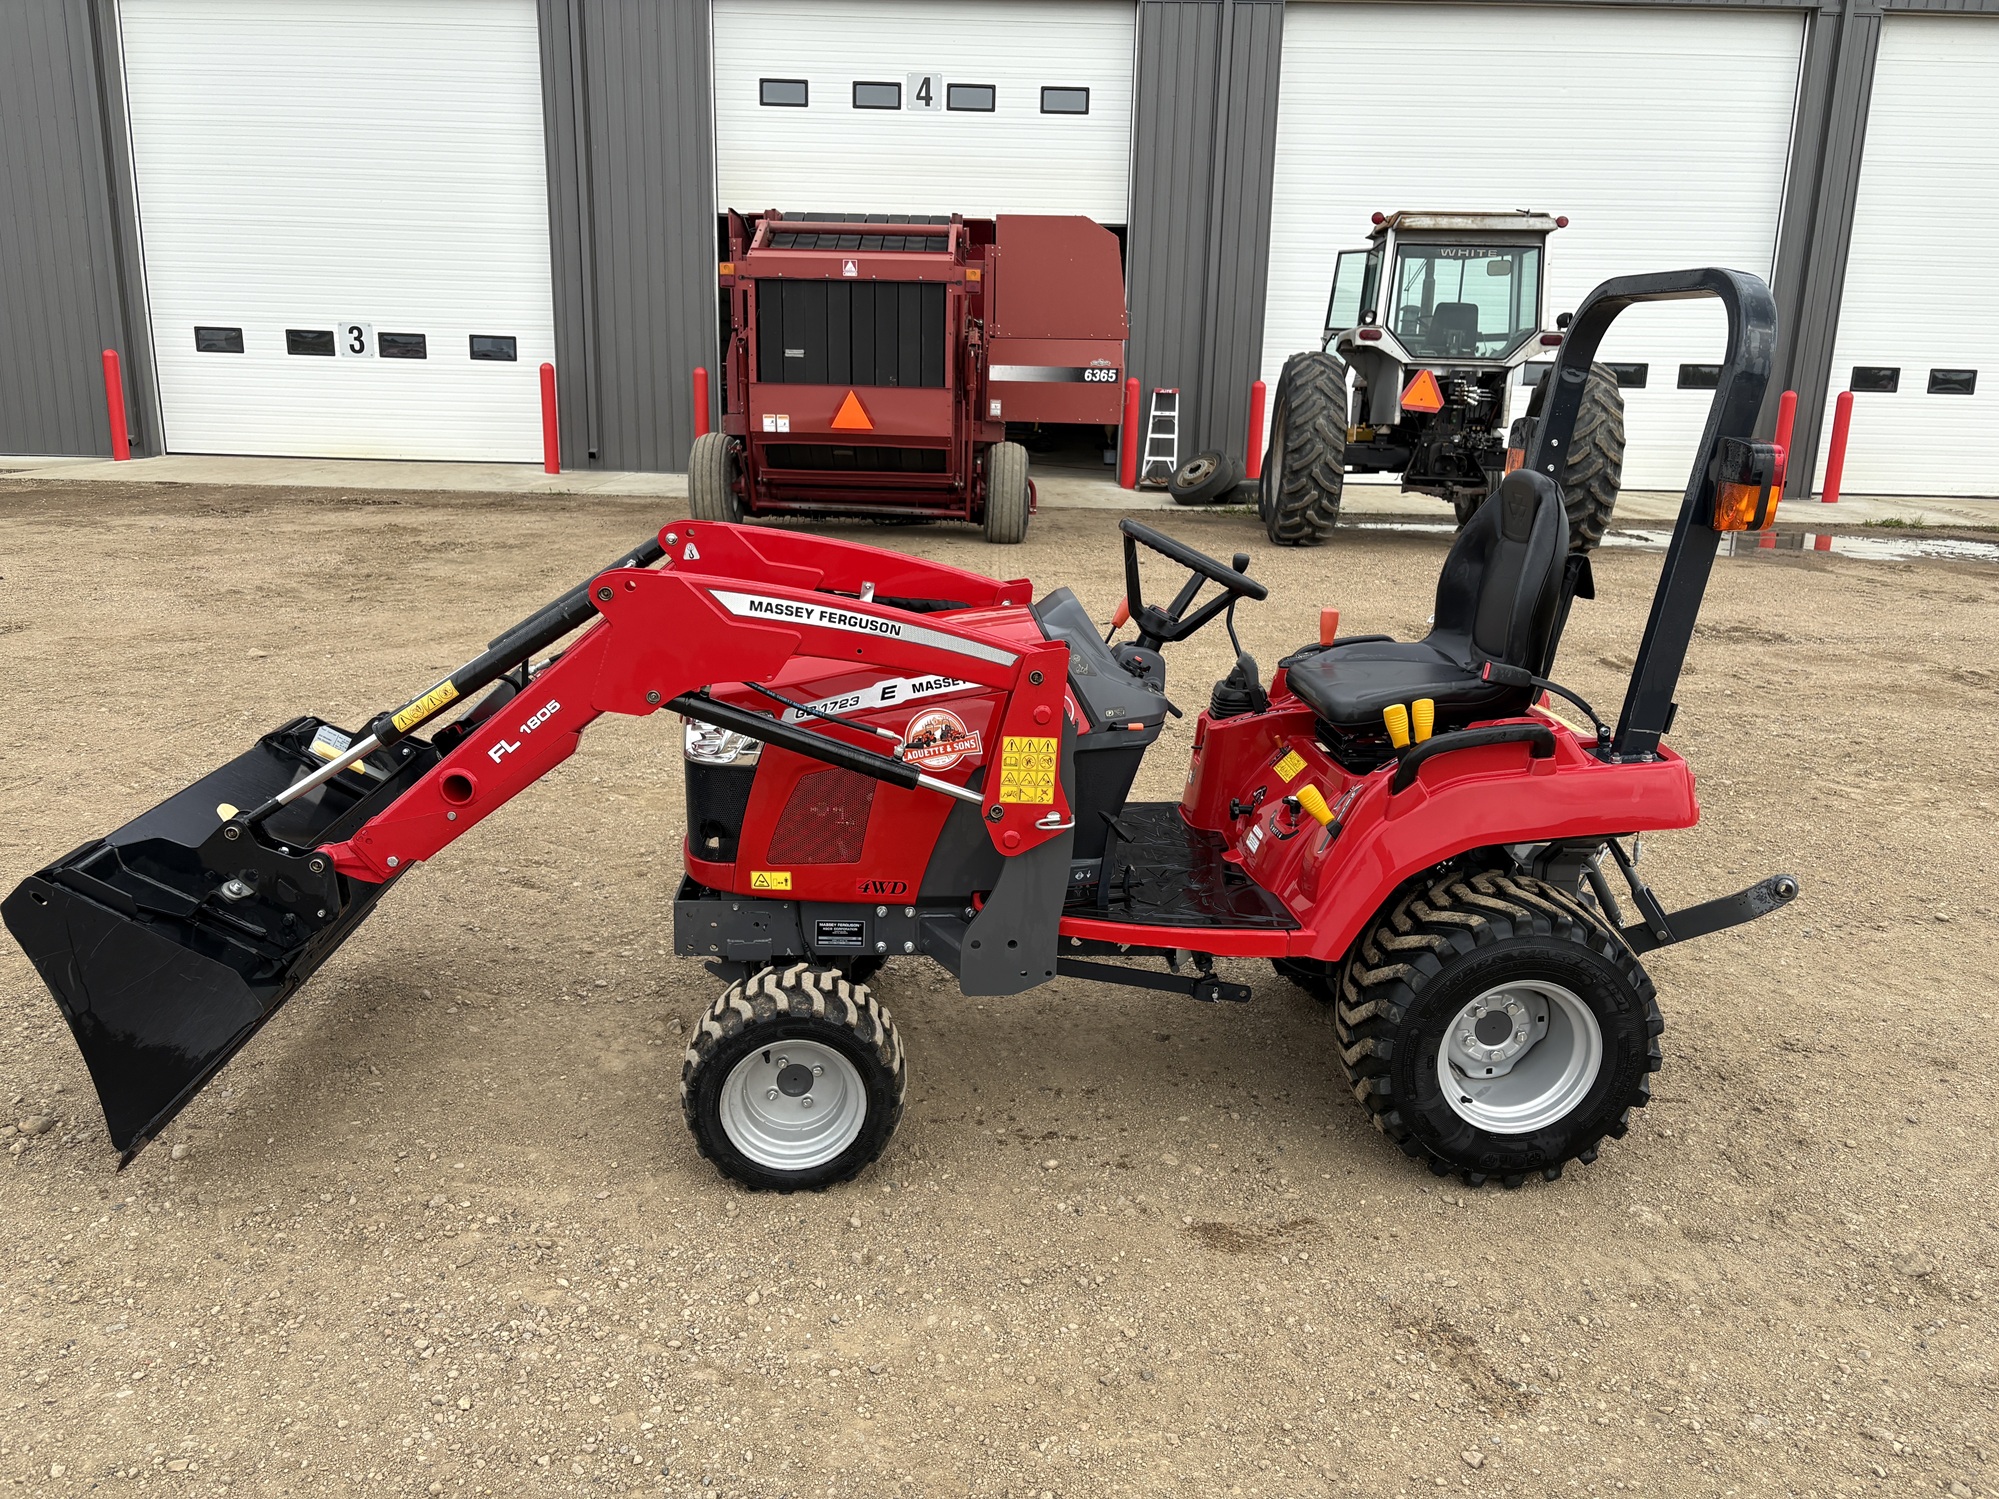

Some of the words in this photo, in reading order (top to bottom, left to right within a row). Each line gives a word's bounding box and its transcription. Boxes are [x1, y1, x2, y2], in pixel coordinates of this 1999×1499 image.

[916, 77, 933, 107] 4
[1440, 248, 1498, 257] WHITE
[348, 325, 365, 354] 3
[1084, 369, 1117, 382] 6365
[749, 600, 815, 619] MASSEY
[819, 610, 902, 637] FERGUSON
[880, 684, 898, 701] E
[487, 739, 522, 764] FL
[519, 699, 561, 734] 1805
[953, 739, 976, 751] SONS
[857, 879, 908, 895] 4WD
